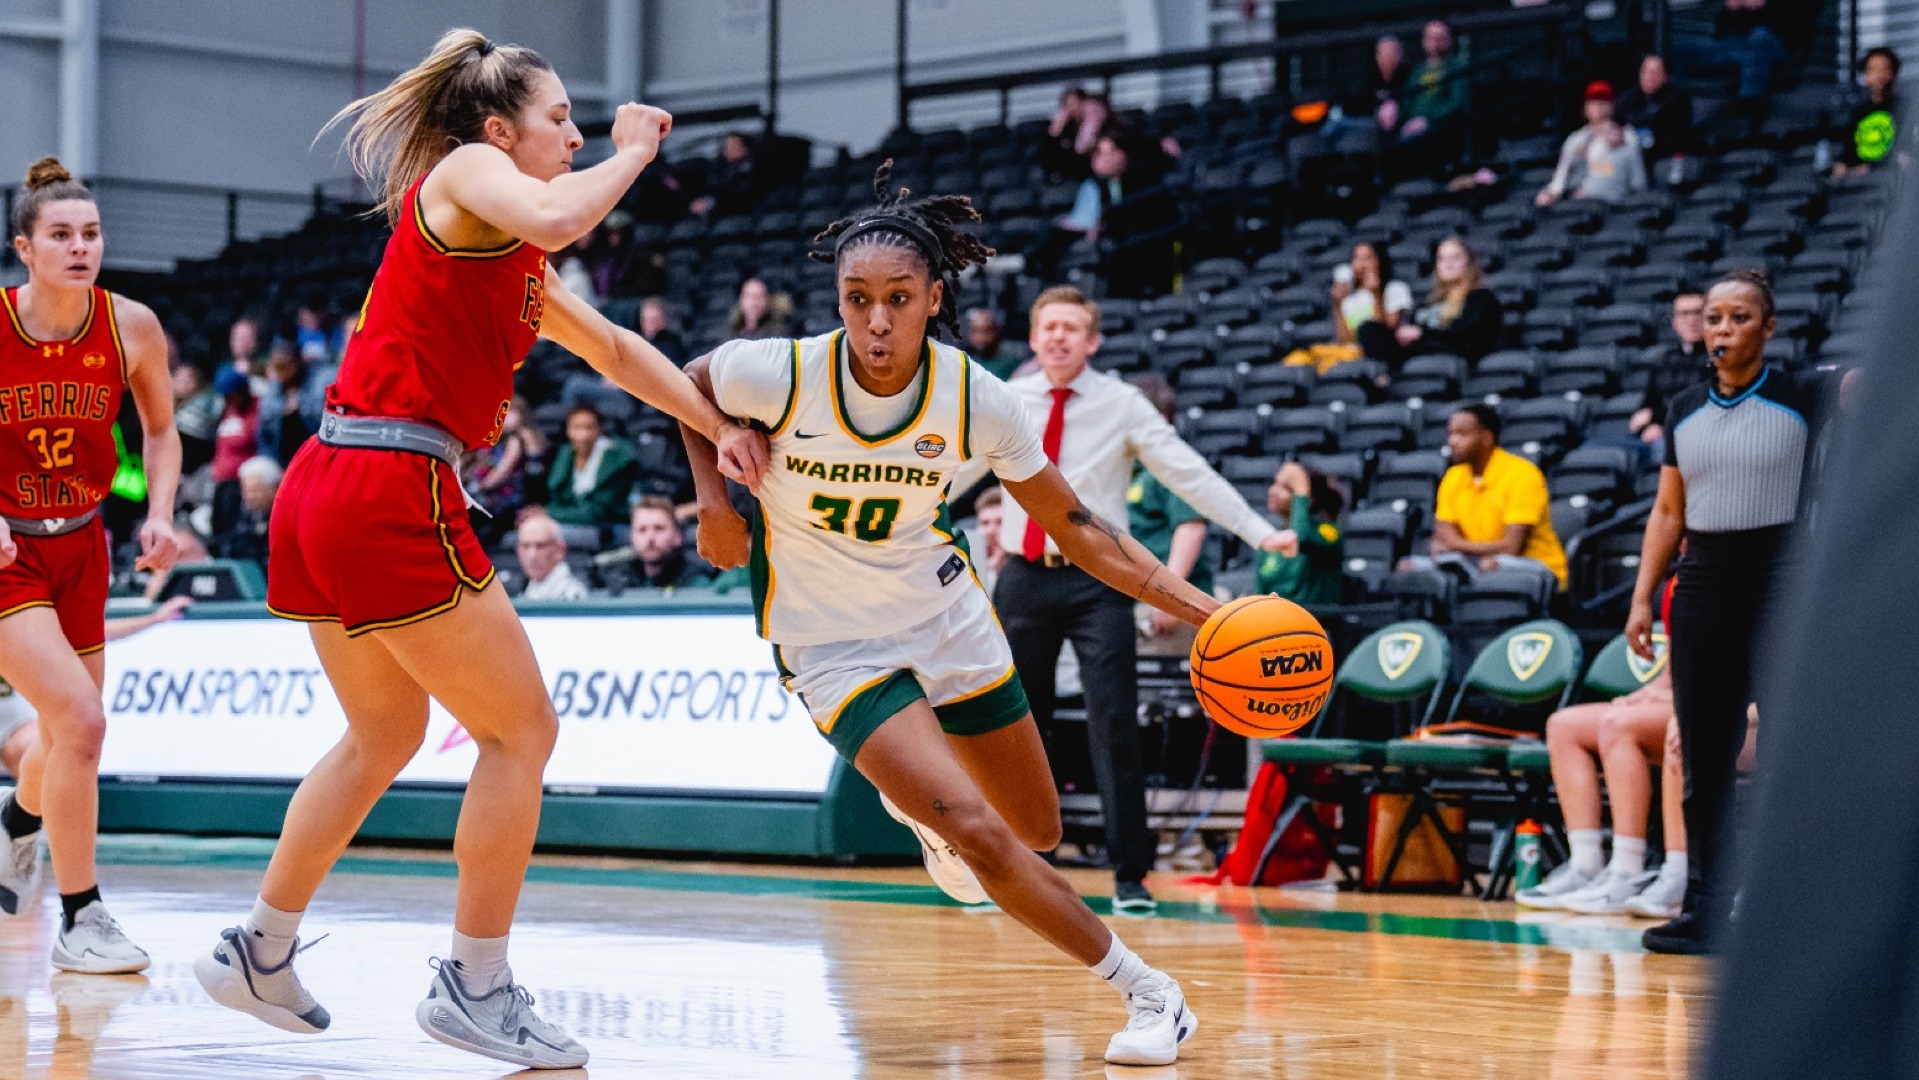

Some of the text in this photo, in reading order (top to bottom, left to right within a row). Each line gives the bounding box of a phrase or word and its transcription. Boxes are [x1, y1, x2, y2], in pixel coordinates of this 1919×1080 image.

[0, 381, 111, 424] FERRIS
[27, 427, 75, 469] 32
[785, 455, 944, 487] WARRIORS
[808, 492, 904, 544] 30
[1260, 651, 1323, 677] NCAA
[1247, 691, 1327, 721] Wilson
